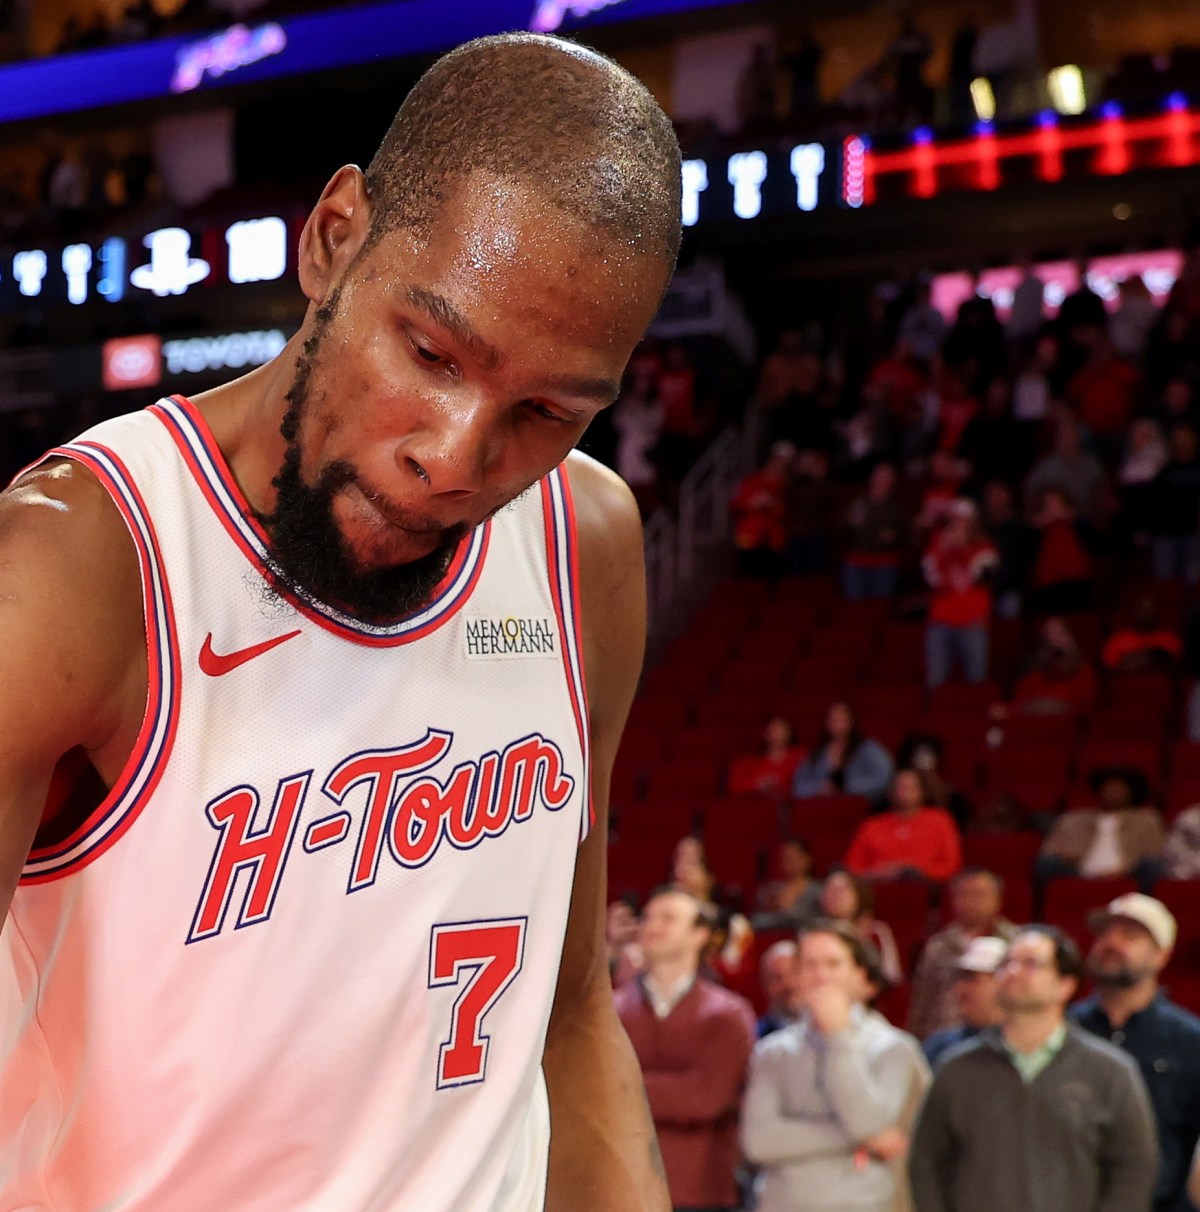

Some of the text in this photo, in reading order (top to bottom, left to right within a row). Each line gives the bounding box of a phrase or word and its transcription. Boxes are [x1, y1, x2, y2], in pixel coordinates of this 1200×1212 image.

[466, 618, 554, 638] MEMORIAL
[467, 635, 555, 655] HERMANN
[184, 727, 575, 945] H-Town
[427, 915, 529, 1091] 7
